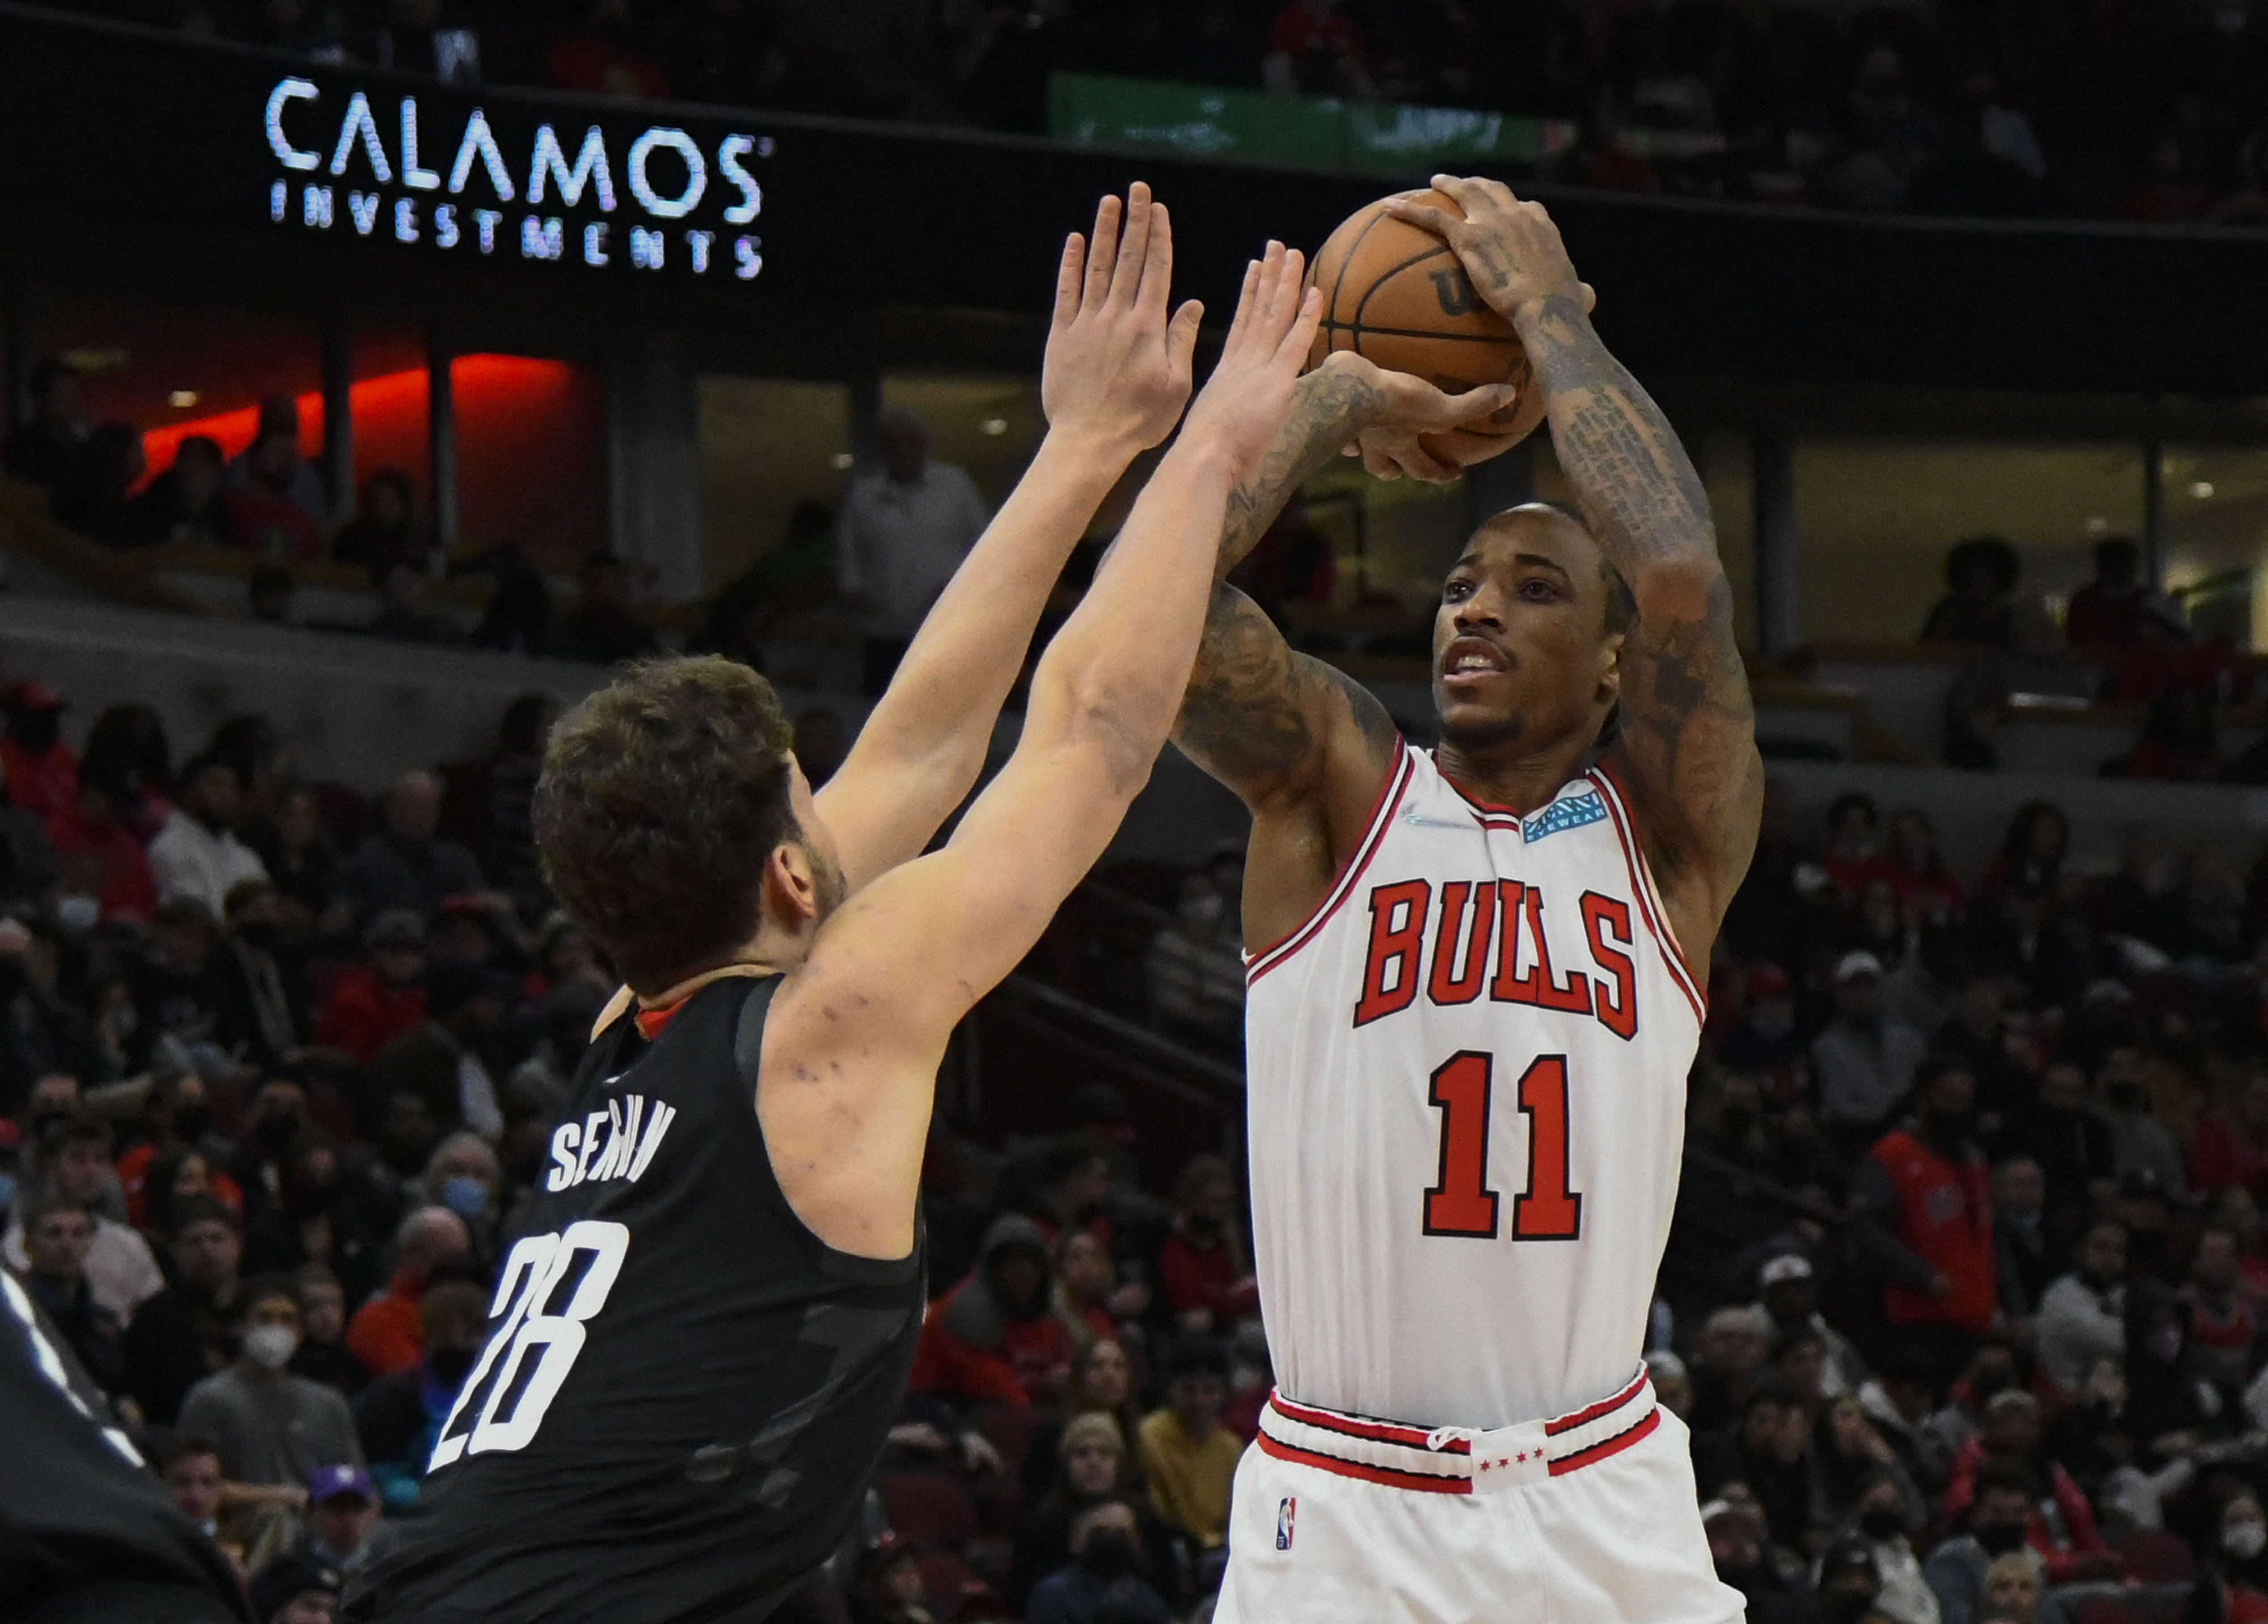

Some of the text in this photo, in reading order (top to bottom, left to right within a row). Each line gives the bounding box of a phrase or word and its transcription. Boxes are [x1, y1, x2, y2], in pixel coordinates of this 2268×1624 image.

[265, 76, 762, 224] CALAMOS
[271, 179, 763, 279] INVESTMENTS
[1527, 807, 1605, 841] EYEWEAR
[1352, 877, 1639, 1042] BULLS
[1422, 1050, 1582, 1241] 11
[426, 1220, 630, 1474] 28
